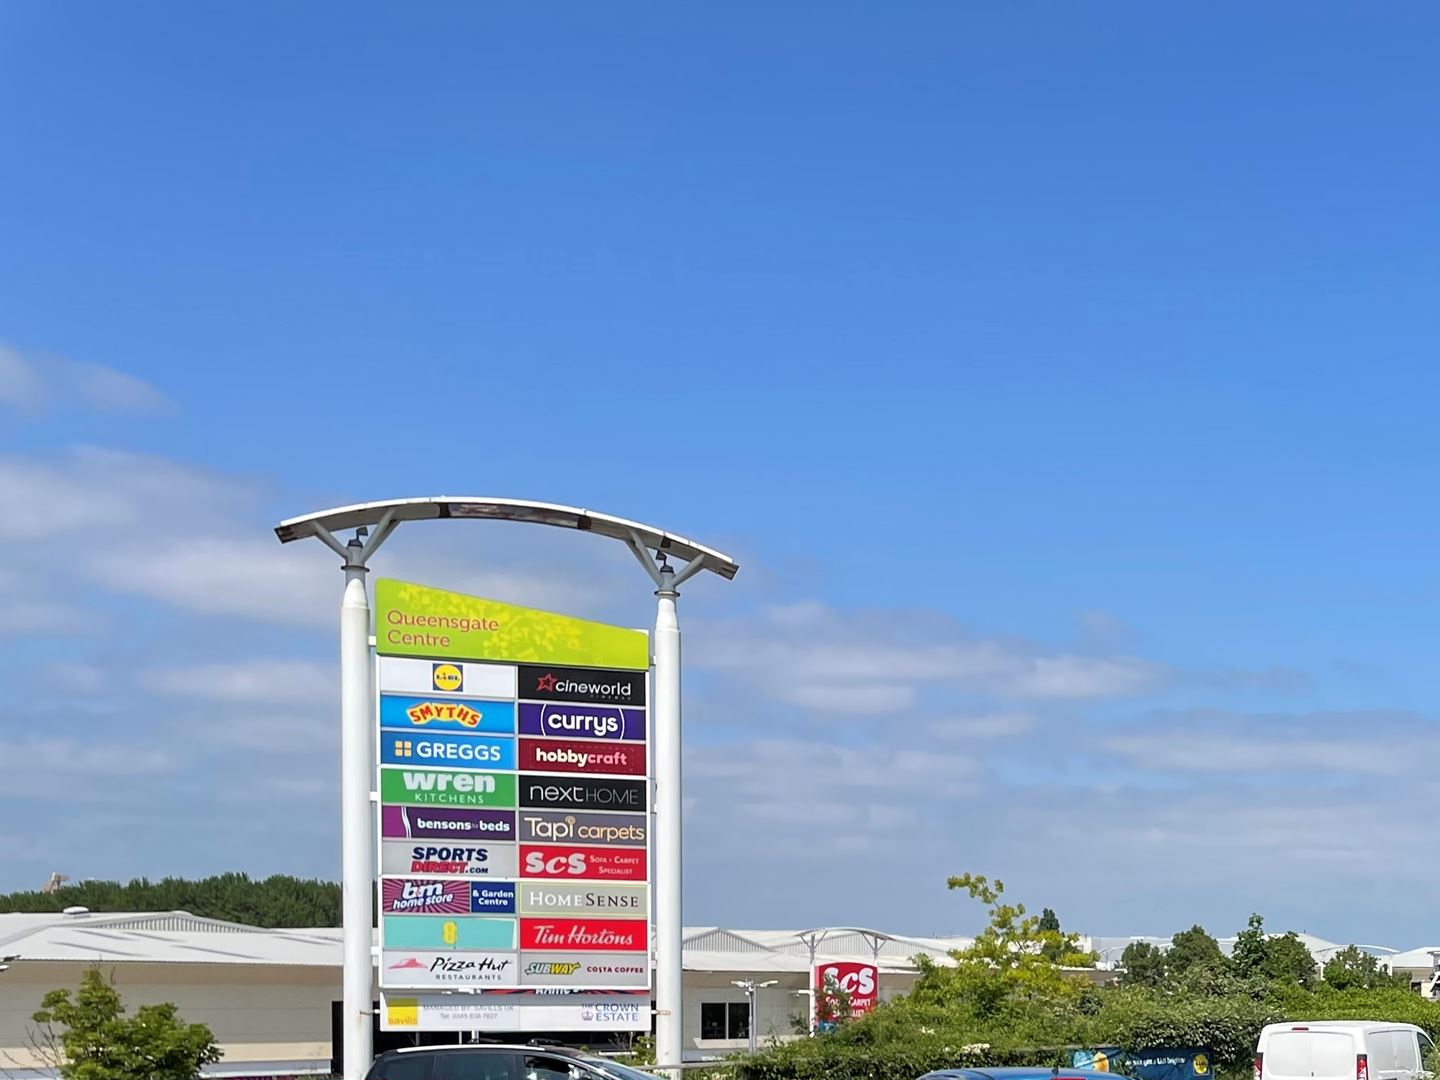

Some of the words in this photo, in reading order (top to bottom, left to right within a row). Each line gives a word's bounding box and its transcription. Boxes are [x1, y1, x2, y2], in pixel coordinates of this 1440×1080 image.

[387, 610, 499, 632] Queensgate
[387, 629, 450, 647] Centre
[555, 680, 631, 696] cineworld
[409, 705, 480, 726] SMYTHS
[416, 742, 501, 761] GREGGS
[536, 747, 627, 767] hobbycraft
[402, 772, 496, 793] wren
[414, 793, 484, 804] KITCHENS
[417, 818, 471, 830] bensons
[480, 820, 510, 832] beds
[524, 816, 576, 842] Tapi
[578, 825, 645, 841] carpets
[412, 847, 488, 862] SPORTS
[525, 851, 587, 874] ScS
[392, 897, 424, 910] home
[425, 893, 454, 905] store
[478, 898, 508, 906] Centre
[483, 890, 514, 898] Garden
[533, 925, 564, 945] Tim
[567, 924, 633, 945] Hortons
[430, 957, 476, 973] Pizza
[477, 957, 512, 972] Hut
[525, 961, 581, 976] SUBWAY
[587, 966, 612, 974] COSTA
[615, 966, 644, 974] COFFEE
[595, 1002, 639, 1012] CROWN
[596, 1012, 639, 1022] ESTATE
